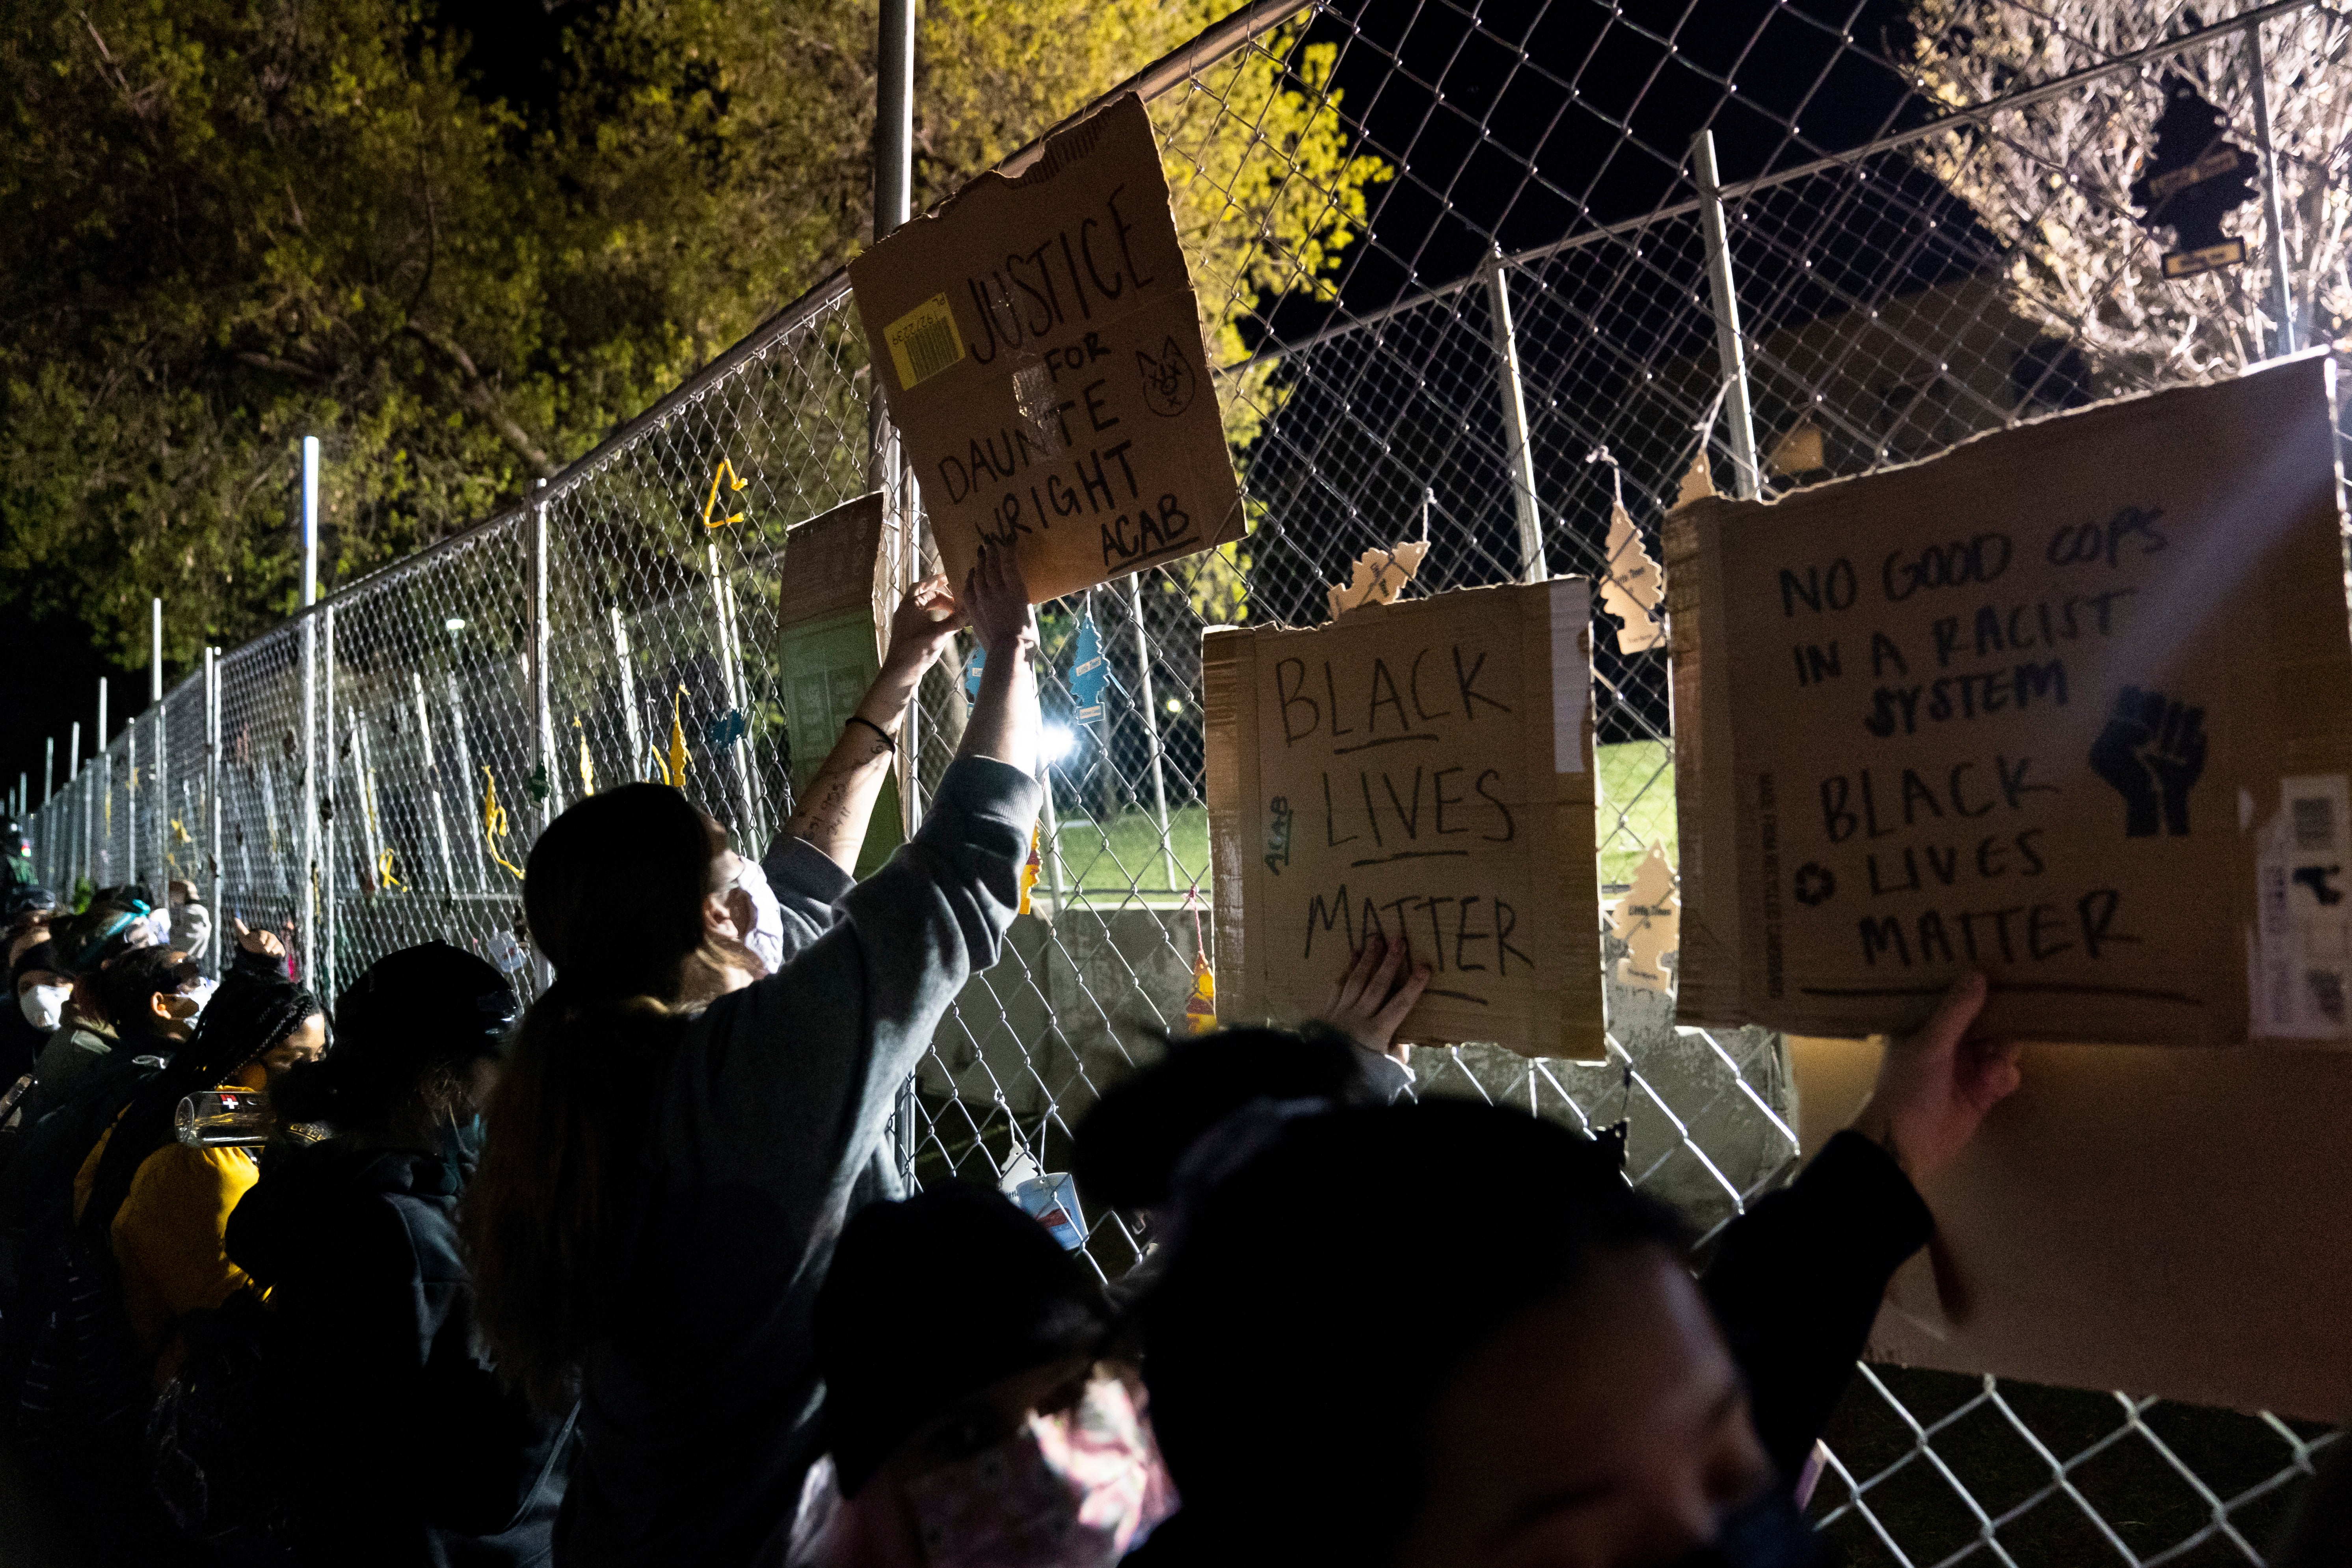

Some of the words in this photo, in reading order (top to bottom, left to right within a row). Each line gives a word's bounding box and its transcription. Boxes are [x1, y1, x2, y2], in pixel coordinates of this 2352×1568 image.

[968, 183, 1155, 366] JUSTICE
[1043, 332, 1112, 383] FOR
[938, 378, 1120, 505] DAUNTE
[974, 439, 1139, 548] WRIGHT
[1100, 493, 1190, 567] ACAB
[1778, 556, 1858, 619] NO
[1881, 532, 2013, 602] GOOD
[2049, 504, 2170, 569] COPS
[1792, 638, 1842, 687] IN
[1870, 631, 1910, 677] A
[1931, 588, 2139, 667] RACIST
[1276, 645, 1510, 749] BLACK
[1862, 656, 2070, 738] SYSTEM
[1264, 794, 1289, 877] ACAB
[1322, 765, 1515, 848] LIVES
[1819, 754, 2063, 844] BLACK
[1866, 827, 2046, 897] LIVES
[1304, 884, 1535, 976] MATTER
[1858, 887, 2144, 967] MATTER
